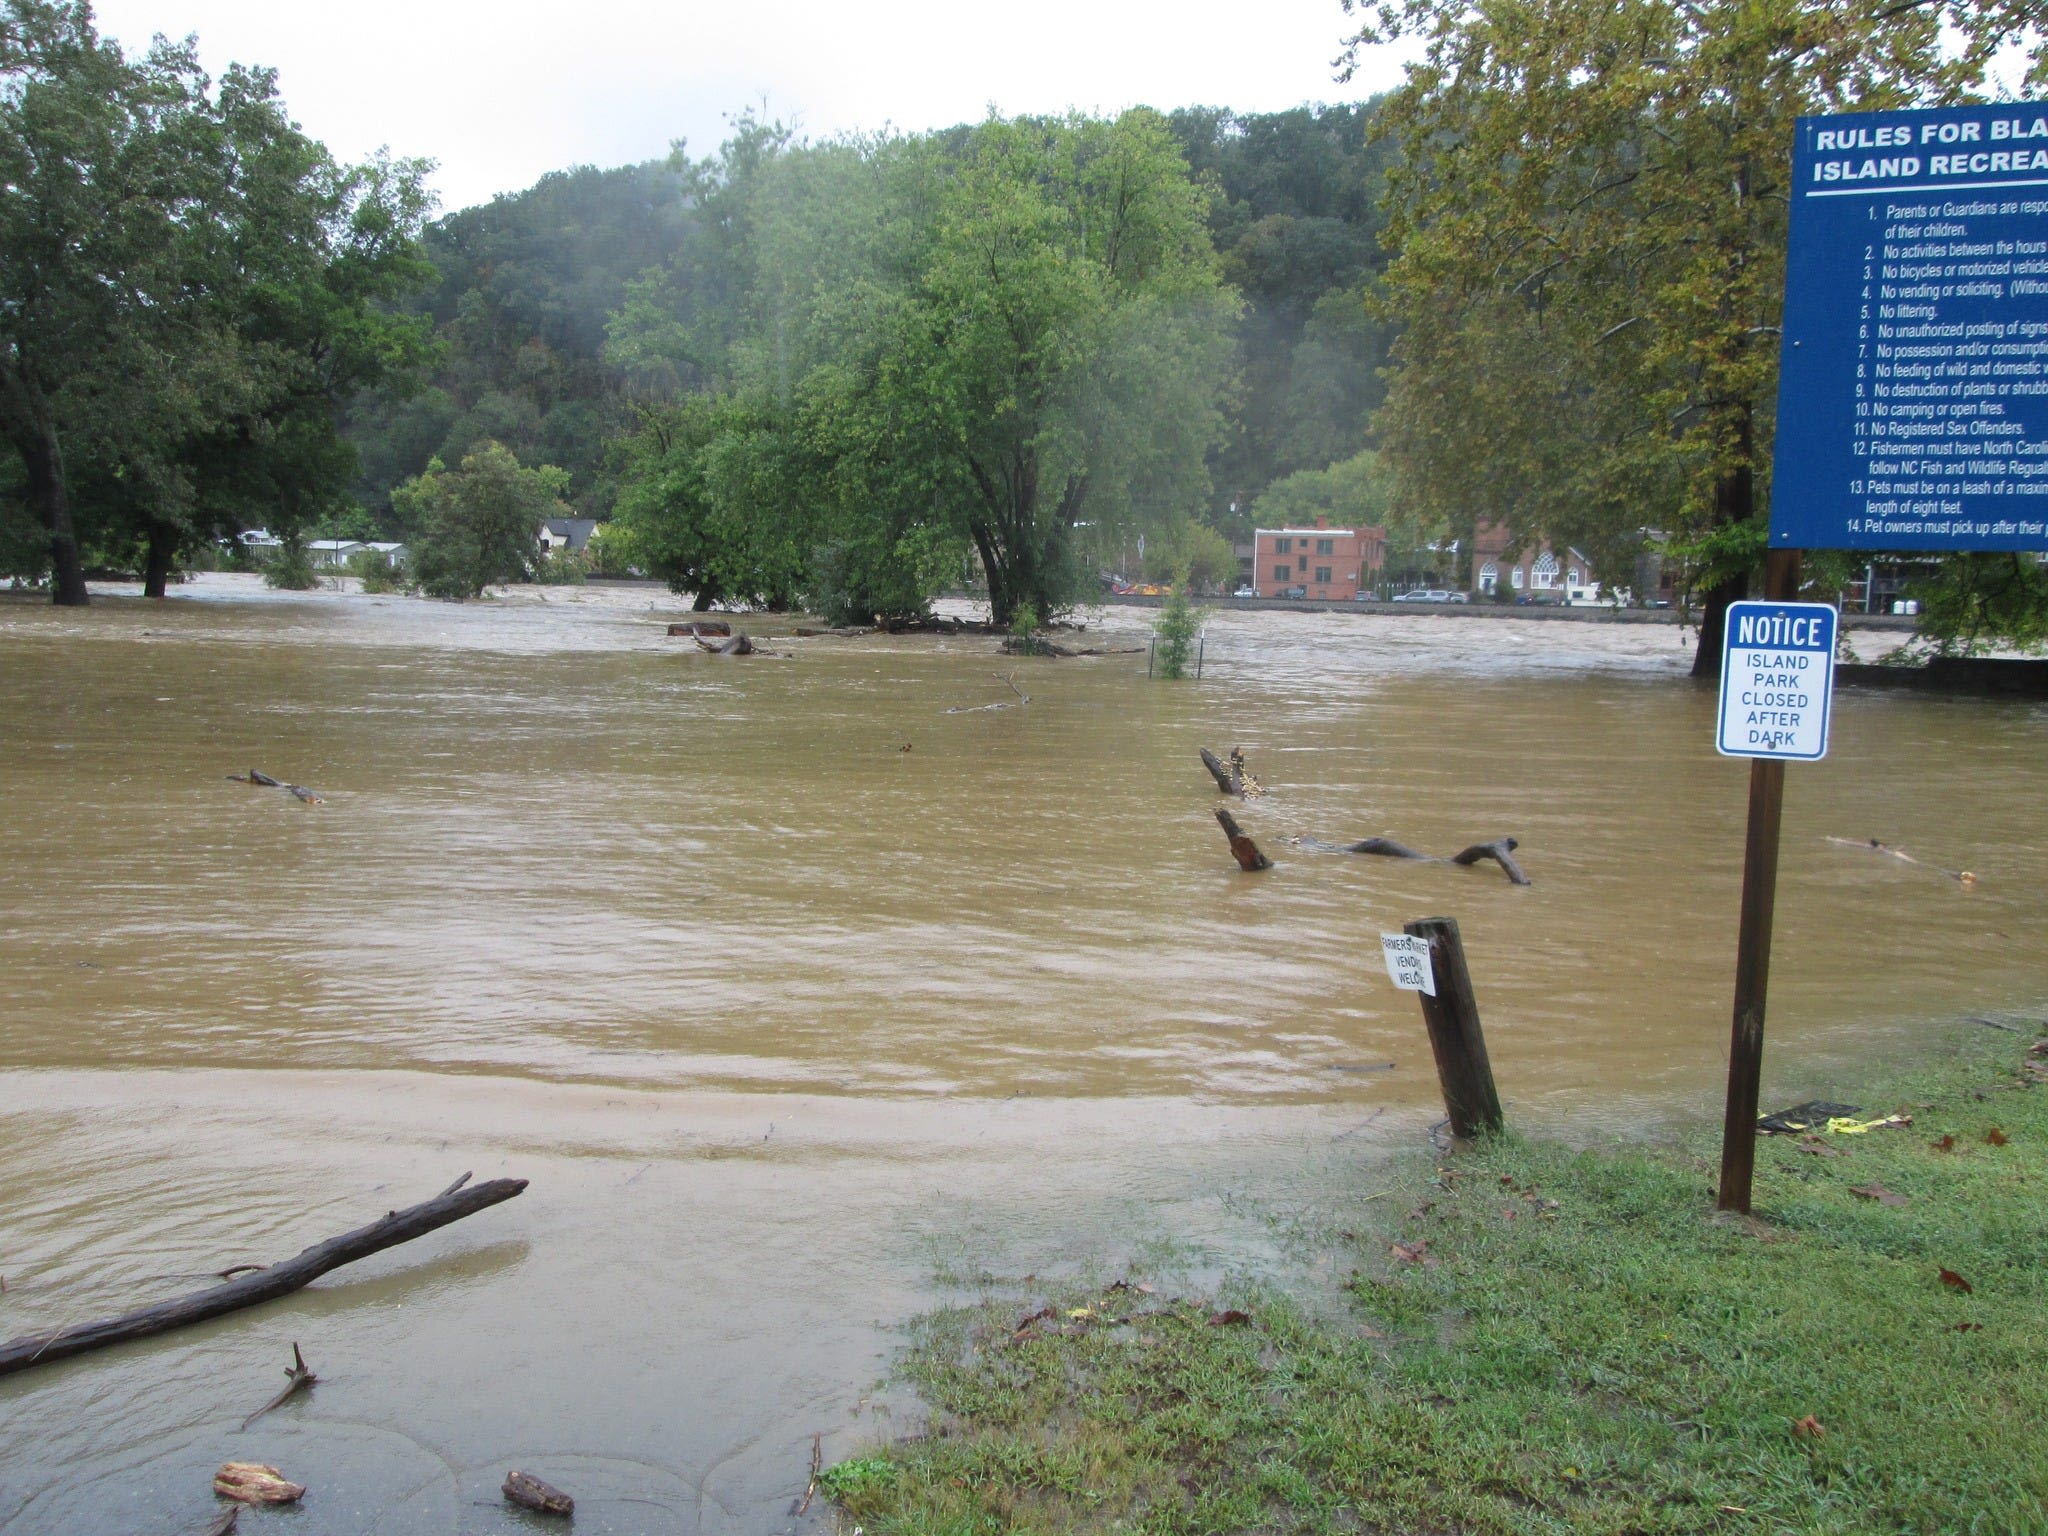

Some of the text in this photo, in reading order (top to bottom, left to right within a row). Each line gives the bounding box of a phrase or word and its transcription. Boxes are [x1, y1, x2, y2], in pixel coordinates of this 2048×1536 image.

[1817, 118, 2048, 150] RULES FOR BLA
[1814, 150, 2048, 181] ISLAND RECREA
[1868, 207, 1878, 220] 1.
[1887, 204, 1927, 219] Parents
[1929, 206, 1941, 216] or
[1943, 200, 1997, 216] Guardians
[2000, 201, 2018, 213] are
[1885, 223, 1968, 239] of their children.
[1865, 240, 2046, 260] 2. No activities between the hours
[1863, 266, 1873, 279] 3.
[1882, 265, 1898, 279] No
[1900, 263, 1942, 281] bicycles
[1944, 265, 1956, 277] or
[1958, 260, 2010, 277] motorized
[1862, 286, 1871, 299] 4.
[1881, 285, 1896, 299] No
[1899, 283, 1939, 300] vending
[1942, 285, 1954, 296] or
[1956, 281, 2004, 298] soliciting.
[1861, 303, 1938, 320] 5. No littering.
[1859, 326, 1870, 338] 6.
[1878, 325, 1894, 338] No
[1896, 322, 1964, 338] unauthorized
[1966, 322, 2004, 338] posting
[2007, 321, 2018, 334] of
[1859, 345, 1868, 358] 7.
[1877, 344, 1892, 358] No
[1894, 342, 1952, 361] possession
[1955, 341, 1990, 356] and/or
[1857, 364, 1866, 377] 8.
[1876, 363, 1891, 377] No
[1893, 362, 1930, 380] feeding
[1934, 361, 1946, 375] of
[1947, 361, 1967, 375] wild
[1970, 360, 1991, 375] and
[1993, 359, 2041, 375] domestic
[1856, 384, 1865, 397] 9.
[1875, 383, 1889, 397] No
[1892, 381, 1948, 397] destruction
[1951, 381, 1963, 395] of
[1964, 380, 1996, 399] plants
[1999, 383, 2011, 394] or
[1856, 401, 2005, 419] 10. No camping or open fires.
[1854, 421, 2025, 438] 11. No Registered Sex Offenders.
[1853, 441, 2048, 455] 12. Fishermen must have North Caroli
[1869, 462, 1898, 474] follow
[1901, 462, 1918, 474] NC
[1921, 461, 1942, 474] Fish
[1945, 461, 1965, 474] and
[1968, 461, 2005, 474] Wildlife
[1850, 481, 1865, 494] 13.
[1868, 481, 1891, 494] Pets
[1894, 482, 1919, 494] must
[1921, 480, 1934, 493] be
[1937, 483, 1950, 493] on
[1953, 483, 1960, 494] a
[1963, 480, 1991, 494] leash
[1994, 480, 2005, 493] of
[2007, 484, 2014, 494] a
[1866, 500, 1963, 516] length of eight feet.
[1847, 520, 1862, 533] 14.
[1865, 520, 1883, 533] Pet
[1885, 522, 1922, 533] owners
[1925, 521, 1950, 533] must
[1952, 520, 1973, 537] pick
[1976, 523, 1988, 536] up
[1992, 521, 2017, 534] after
[2019, 520, 2042, 534] their
[1739, 616, 1822, 646] NOTICE
[1747, 654, 1809, 669] ISLAND
[1754, 673, 1799, 688] PARK
[1742, 692, 1808, 707] CLOSED
[1746, 711, 1800, 726] AFTER
[1749, 730, 1794, 745] DARK
